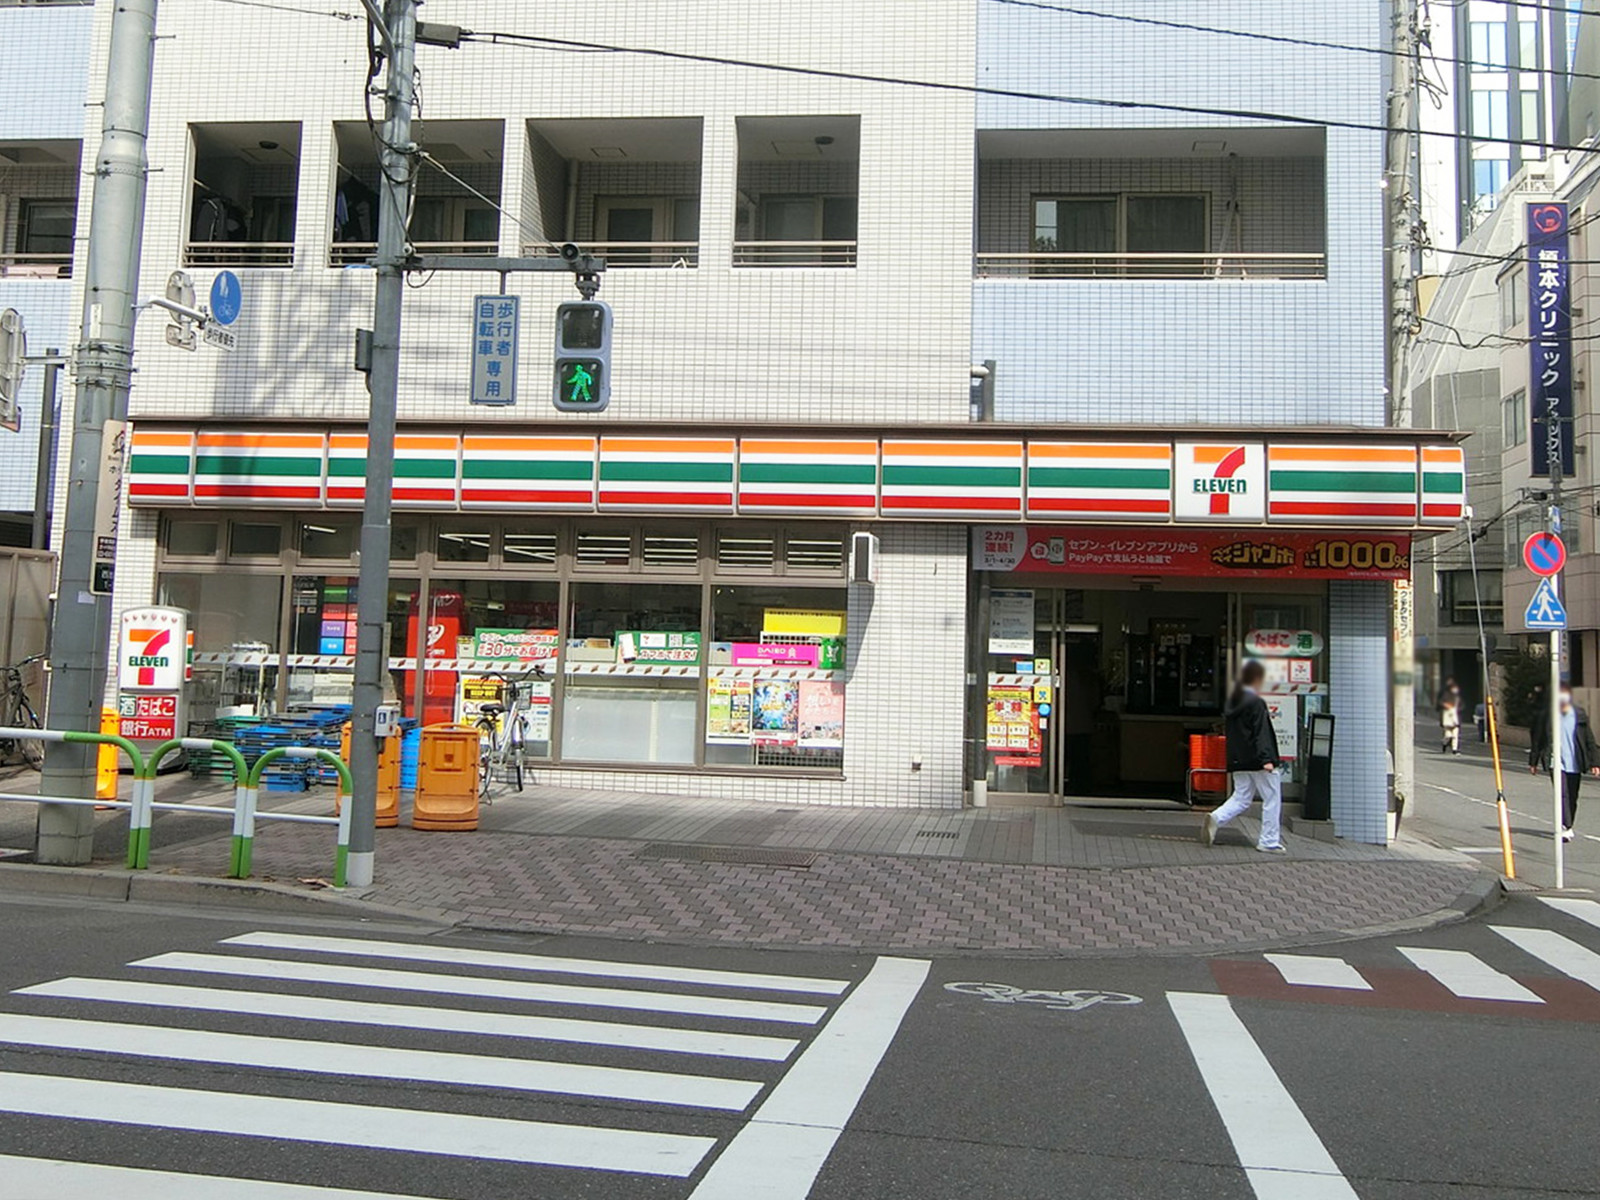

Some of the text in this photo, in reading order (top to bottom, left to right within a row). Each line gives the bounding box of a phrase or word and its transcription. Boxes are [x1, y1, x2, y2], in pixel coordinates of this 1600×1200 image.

[478, 302, 495, 356] 自転車
[496, 303, 513, 357] 歩行者
[485, 360, 502, 397] 専用
[1254, 633, 1313, 649] たばこ 酒
[120, 696, 175, 716] 酒 たばこ
